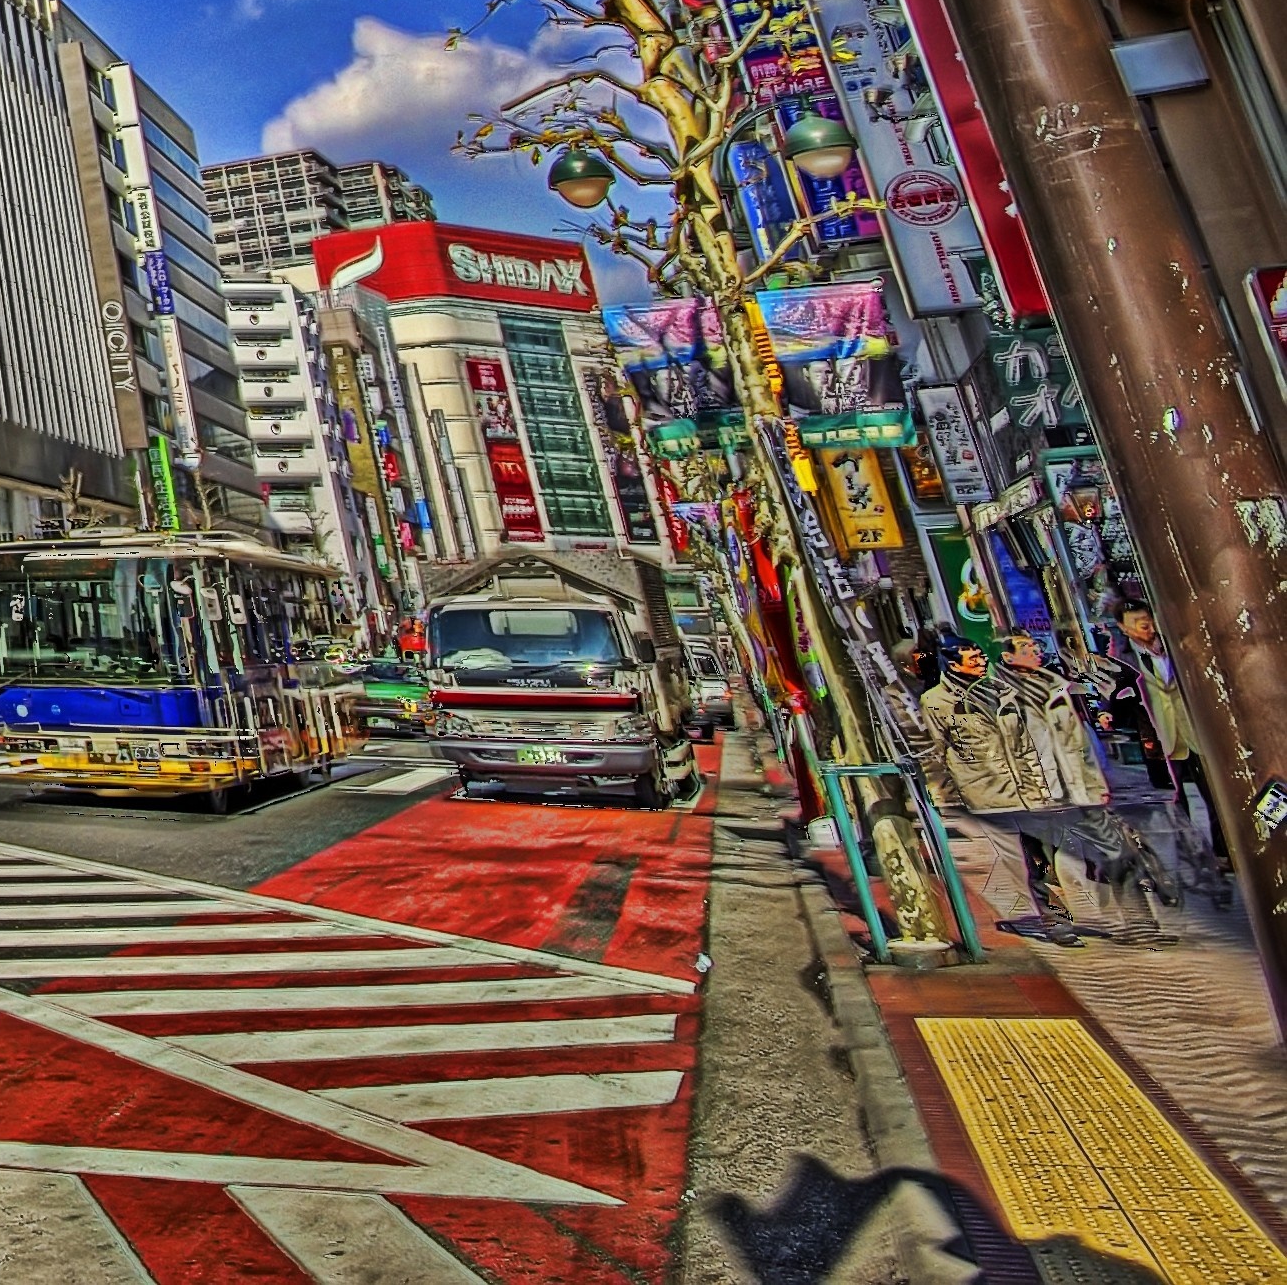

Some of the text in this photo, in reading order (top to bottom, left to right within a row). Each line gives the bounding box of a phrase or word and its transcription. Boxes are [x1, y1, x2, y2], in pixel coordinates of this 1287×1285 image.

[825, 223, 852, 237] 3F
[447, 242, 593, 296] SHIDAX
[941, 270, 962, 305] STORE
